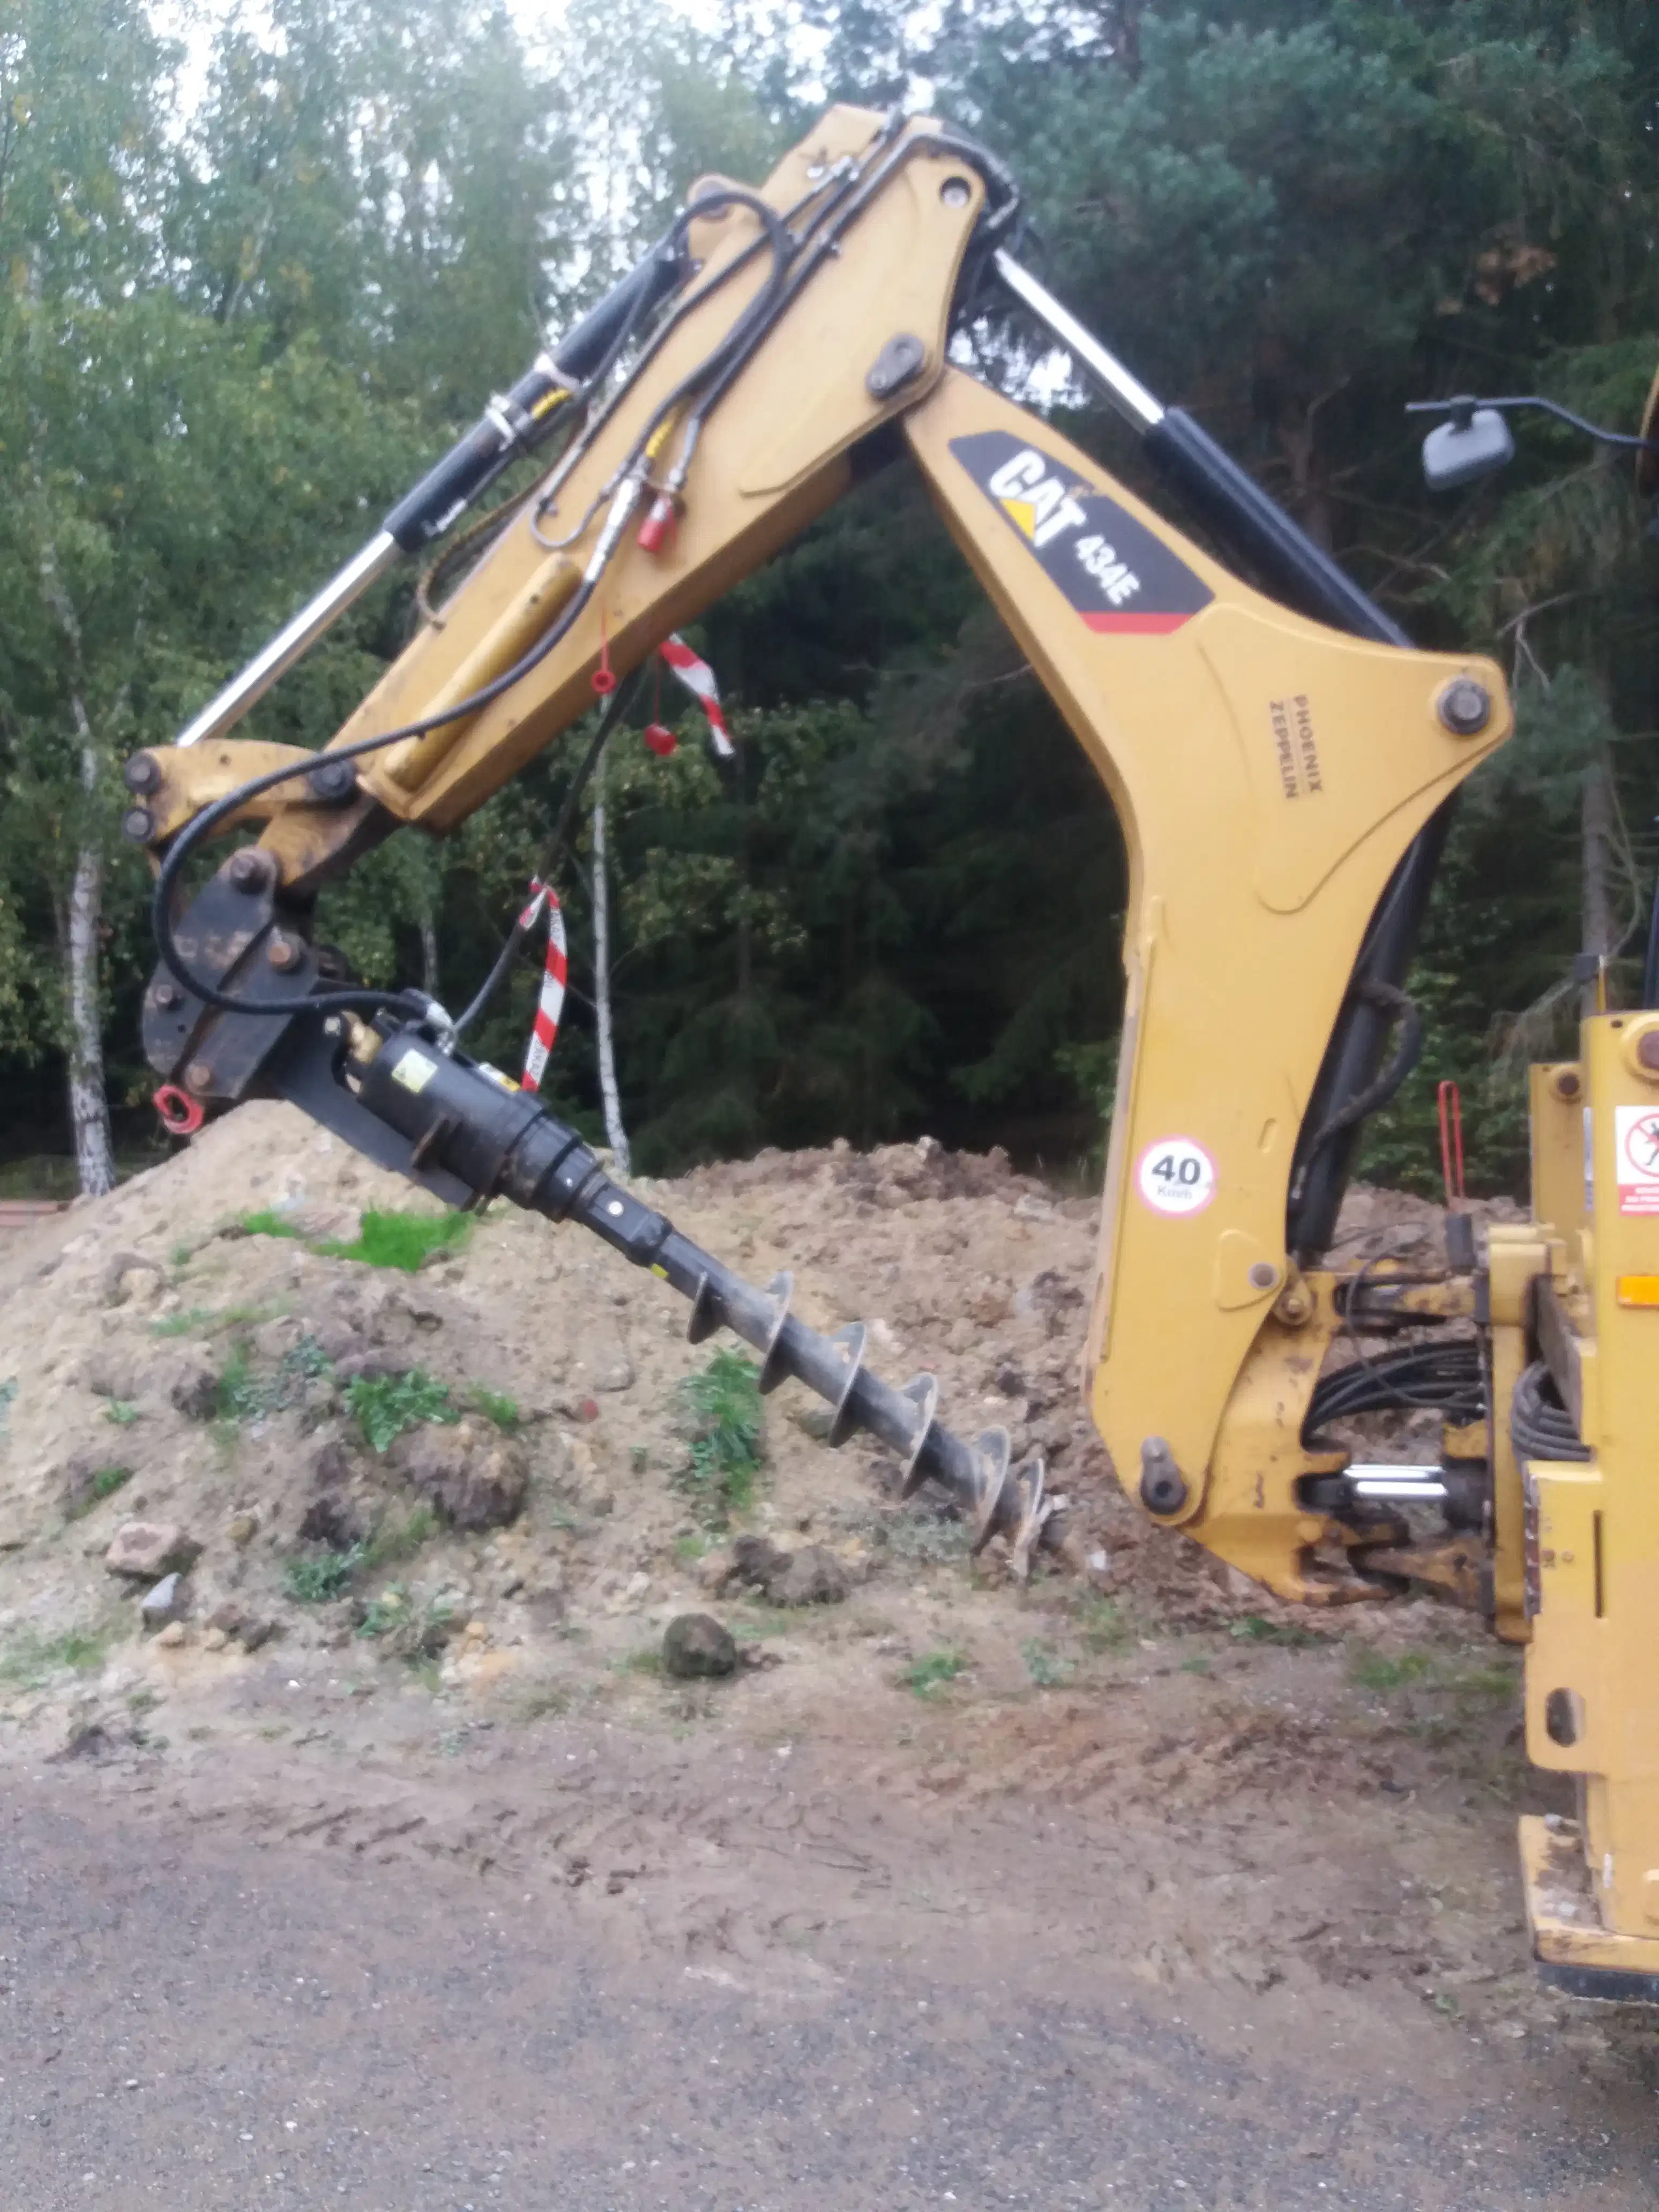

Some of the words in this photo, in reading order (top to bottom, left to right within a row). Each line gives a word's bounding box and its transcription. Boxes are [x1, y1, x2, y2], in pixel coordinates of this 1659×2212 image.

[989, 450, 1086, 548] CAT
[1074, 534, 1140, 606] 434E
[1269, 700, 1299, 798] ZEPPELIN
[1293, 694, 1322, 793] PHOENIX
[1152, 1155, 1200, 1185] 40
